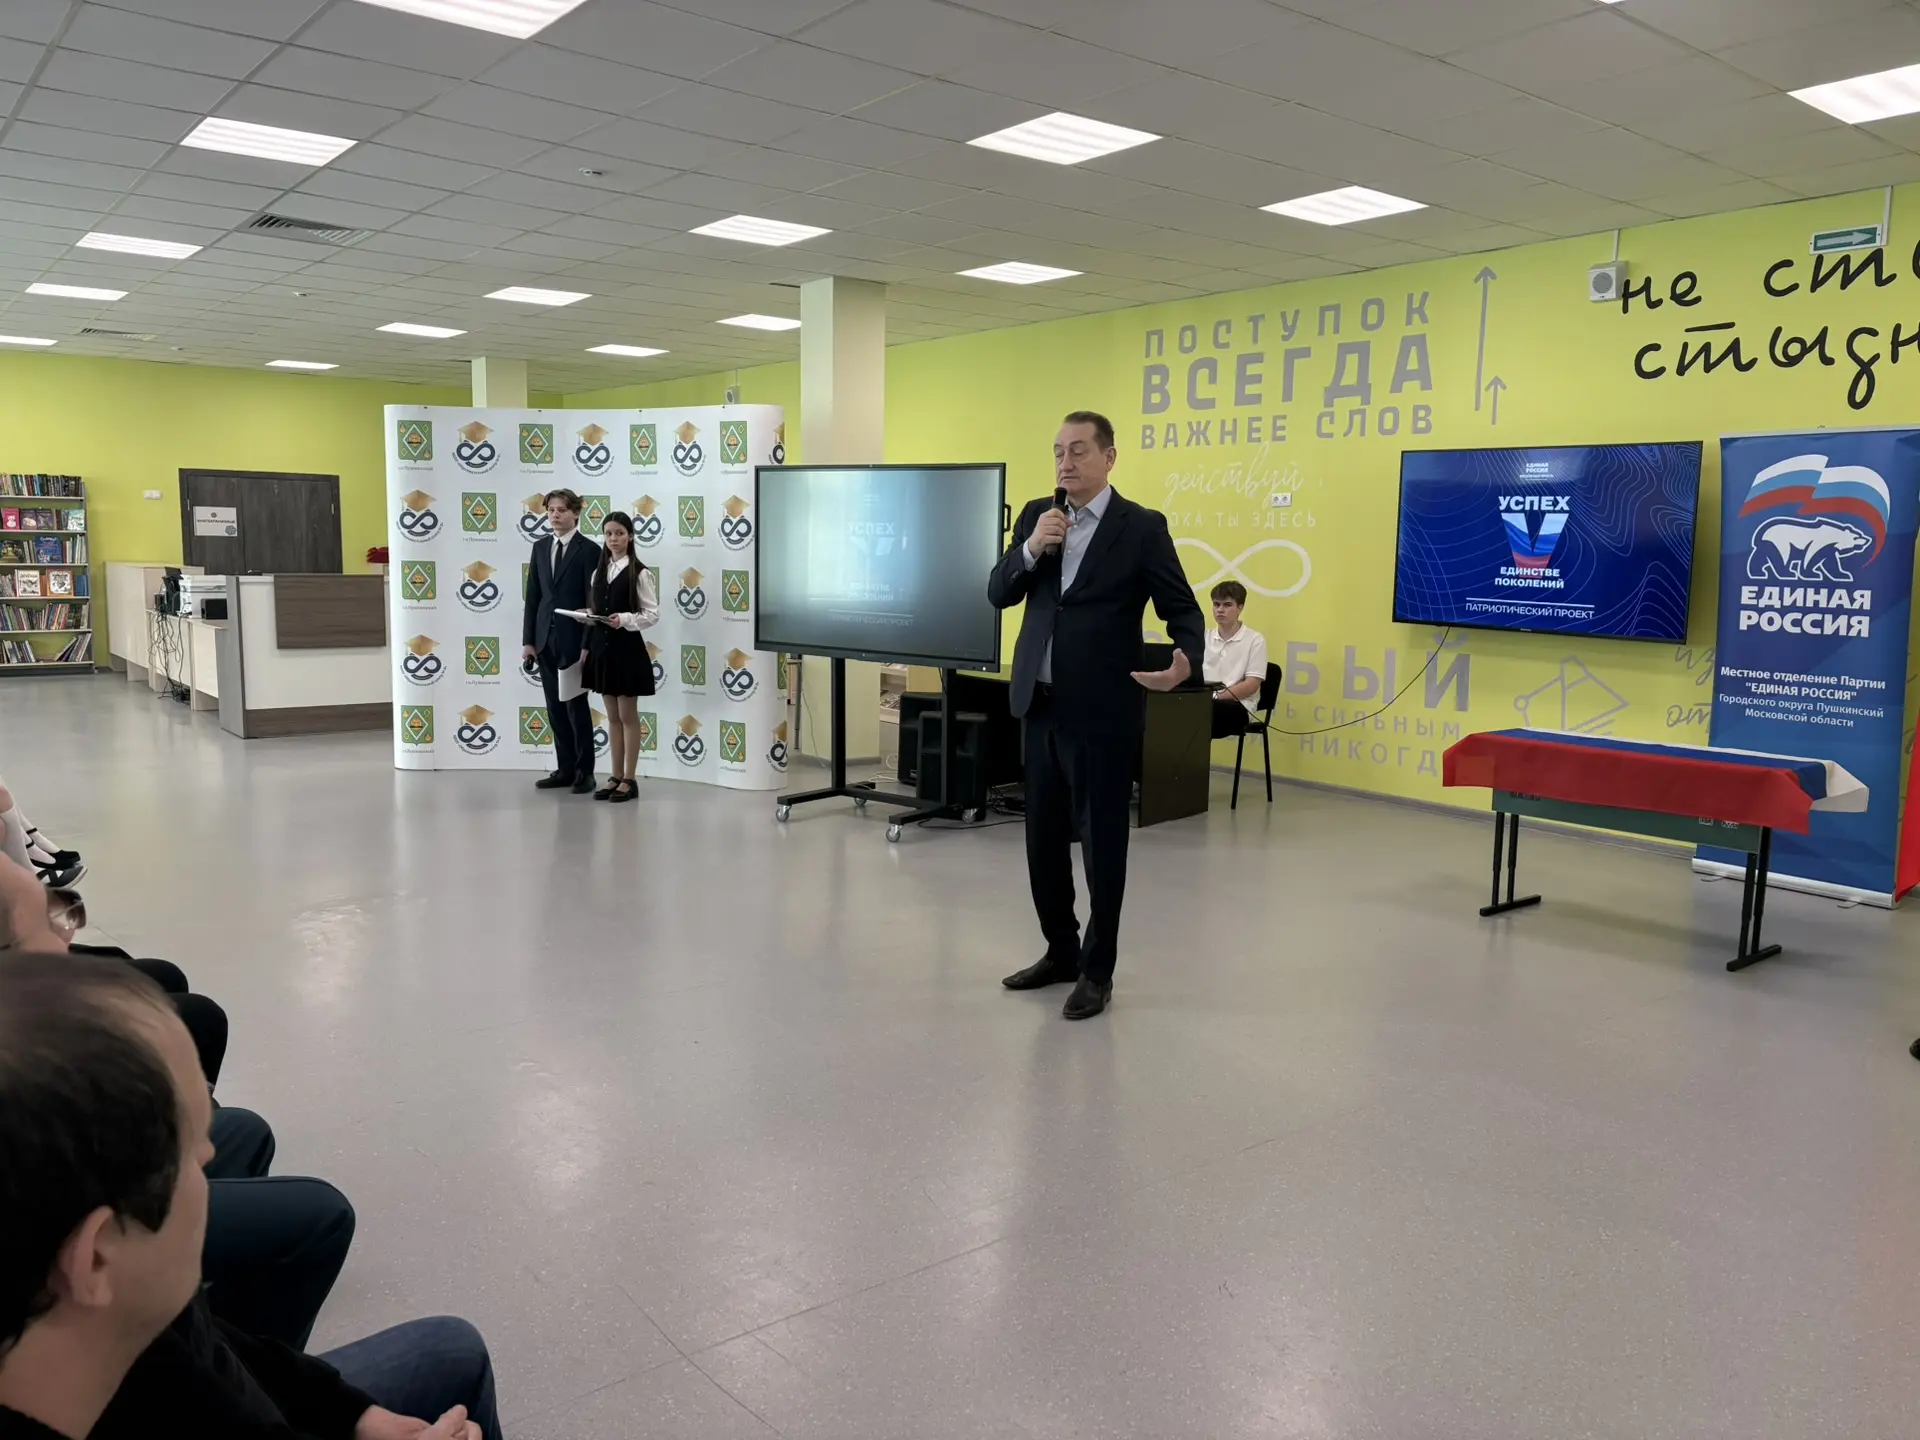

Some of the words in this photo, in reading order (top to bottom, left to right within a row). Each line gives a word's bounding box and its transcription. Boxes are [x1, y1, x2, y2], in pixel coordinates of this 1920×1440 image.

[1622, 270, 1702, 314] не
[1144, 291, 1430, 359] ПОСТУПОК
[1141, 333, 1433, 415] ВСЕГДА
[1141, 414, 1288, 450] ВАЖНЕЕ
[1315, 404, 1433, 439] СЛОВ
[1498, 495, 1571, 511] УСПЕХ
[1167, 510, 1204, 529] ОКА
[1216, 510, 1240, 528] ТЫ
[1252, 509, 1317, 530] ЗДЕСЬ
[1494, 578, 1564, 589] ПОКОЛЕНИЙ
[1500, 566, 1560, 577] ЕДИНСТВЕ
[1740, 585, 1872, 610] ЕДИНАЯ
[1465, 602, 1553, 616] ПАТРИОТИЧЕСКИЙ
[1553, 608, 1595, 619] ПРОЕКТ
[1739, 610, 1870, 638] РОССИЯ
[1720, 666, 1771, 680] Местное
[1773, 670, 1838, 685] отделение
[1840, 675, 1886, 690] Партии
[1745, 682, 1798, 696] "ЕДИНАЯ
[1801, 688, 1857, 701] РОССИЯ"
[1719, 693, 1776, 707] Городского
[1778, 698, 1814, 712] округа
[1817, 702, 1884, 718] Пушкинский
[1745, 708, 1808, 723] Московской
[1810, 713, 1854, 728] области
[1313, 704, 1461, 742] СИЛЬНЫМ
[1299, 732, 1438, 778] НИКОГД
